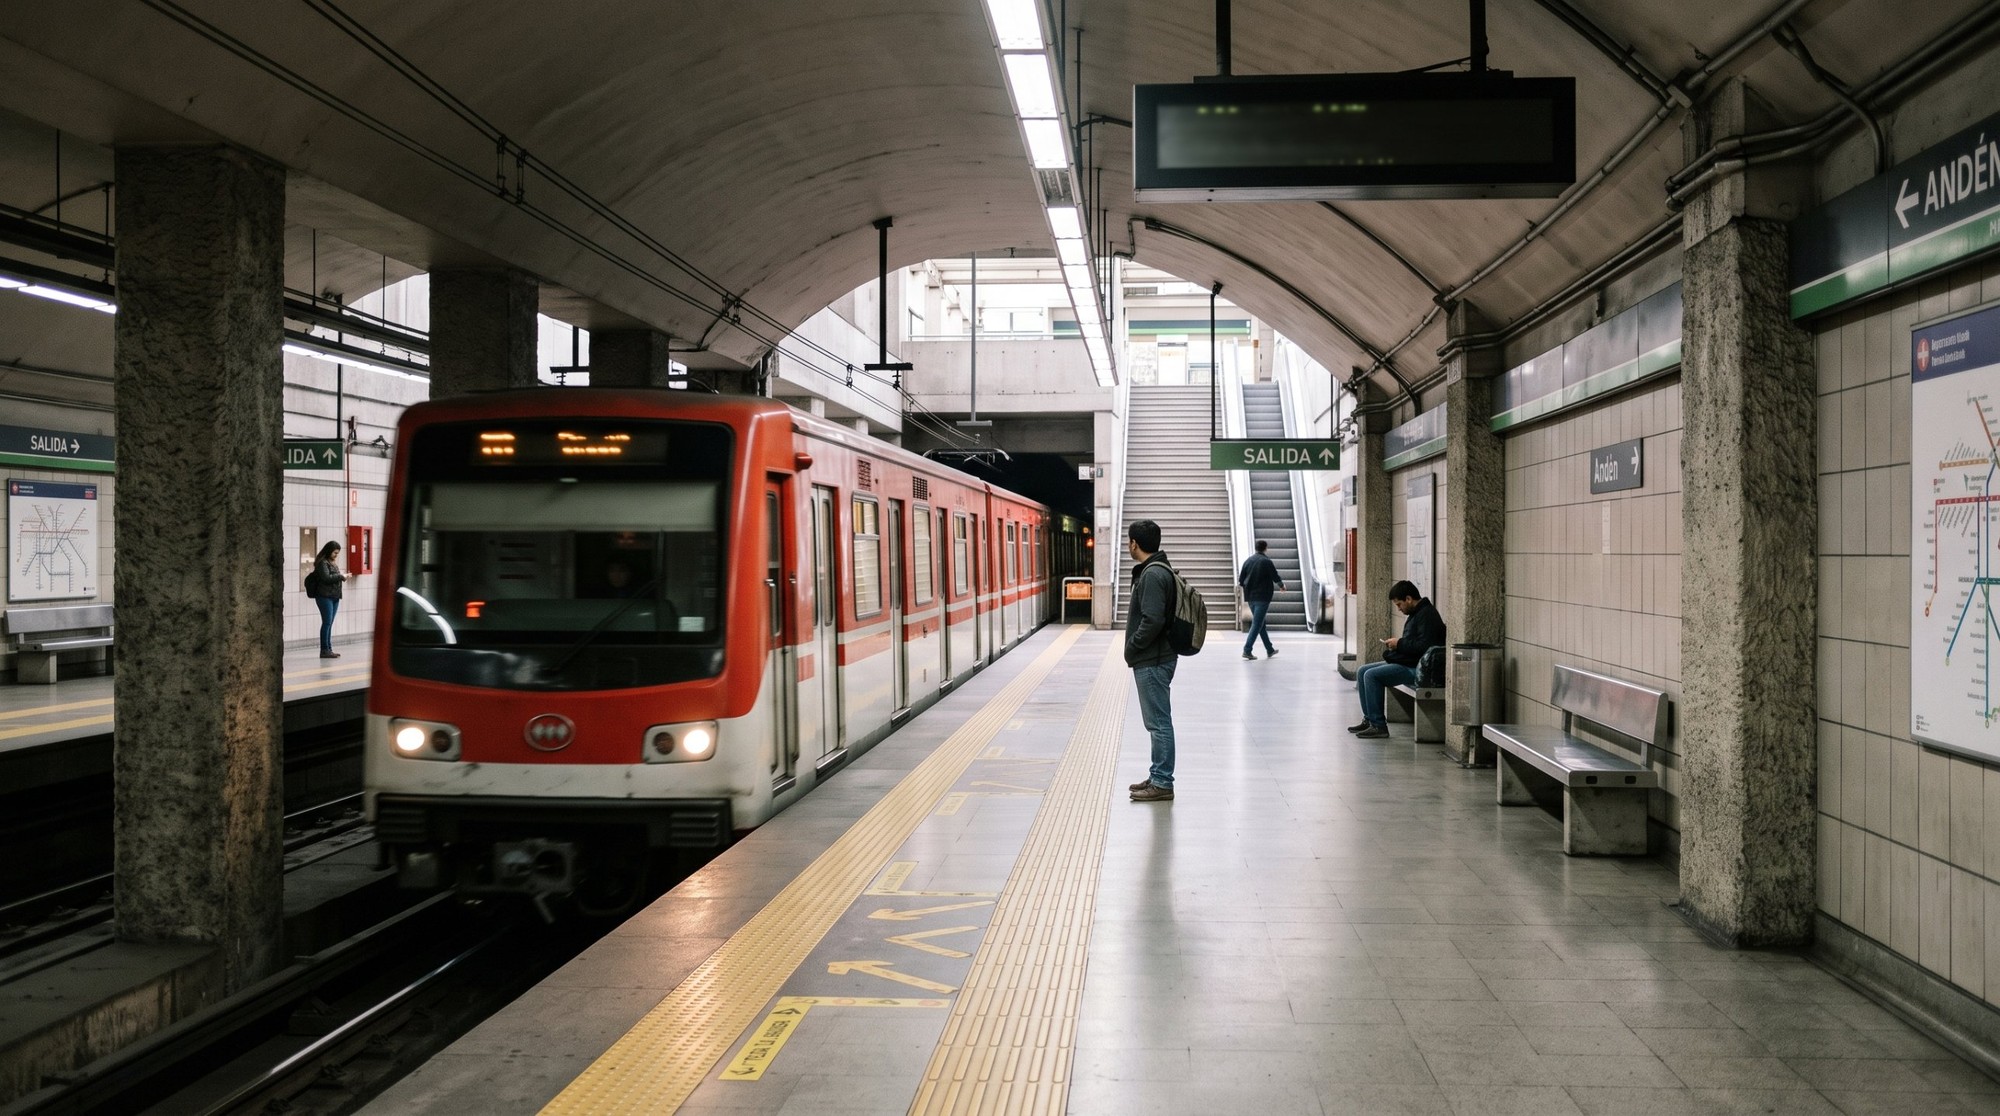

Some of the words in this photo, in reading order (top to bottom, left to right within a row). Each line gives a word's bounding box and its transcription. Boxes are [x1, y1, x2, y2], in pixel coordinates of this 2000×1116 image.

[1924, 132, 2000, 215] ANDÉN
[31, 435, 68, 453] SALIDA
[1243, 448, 1311, 464] SALIDA
[1594, 454, 1618, 484] Andén
